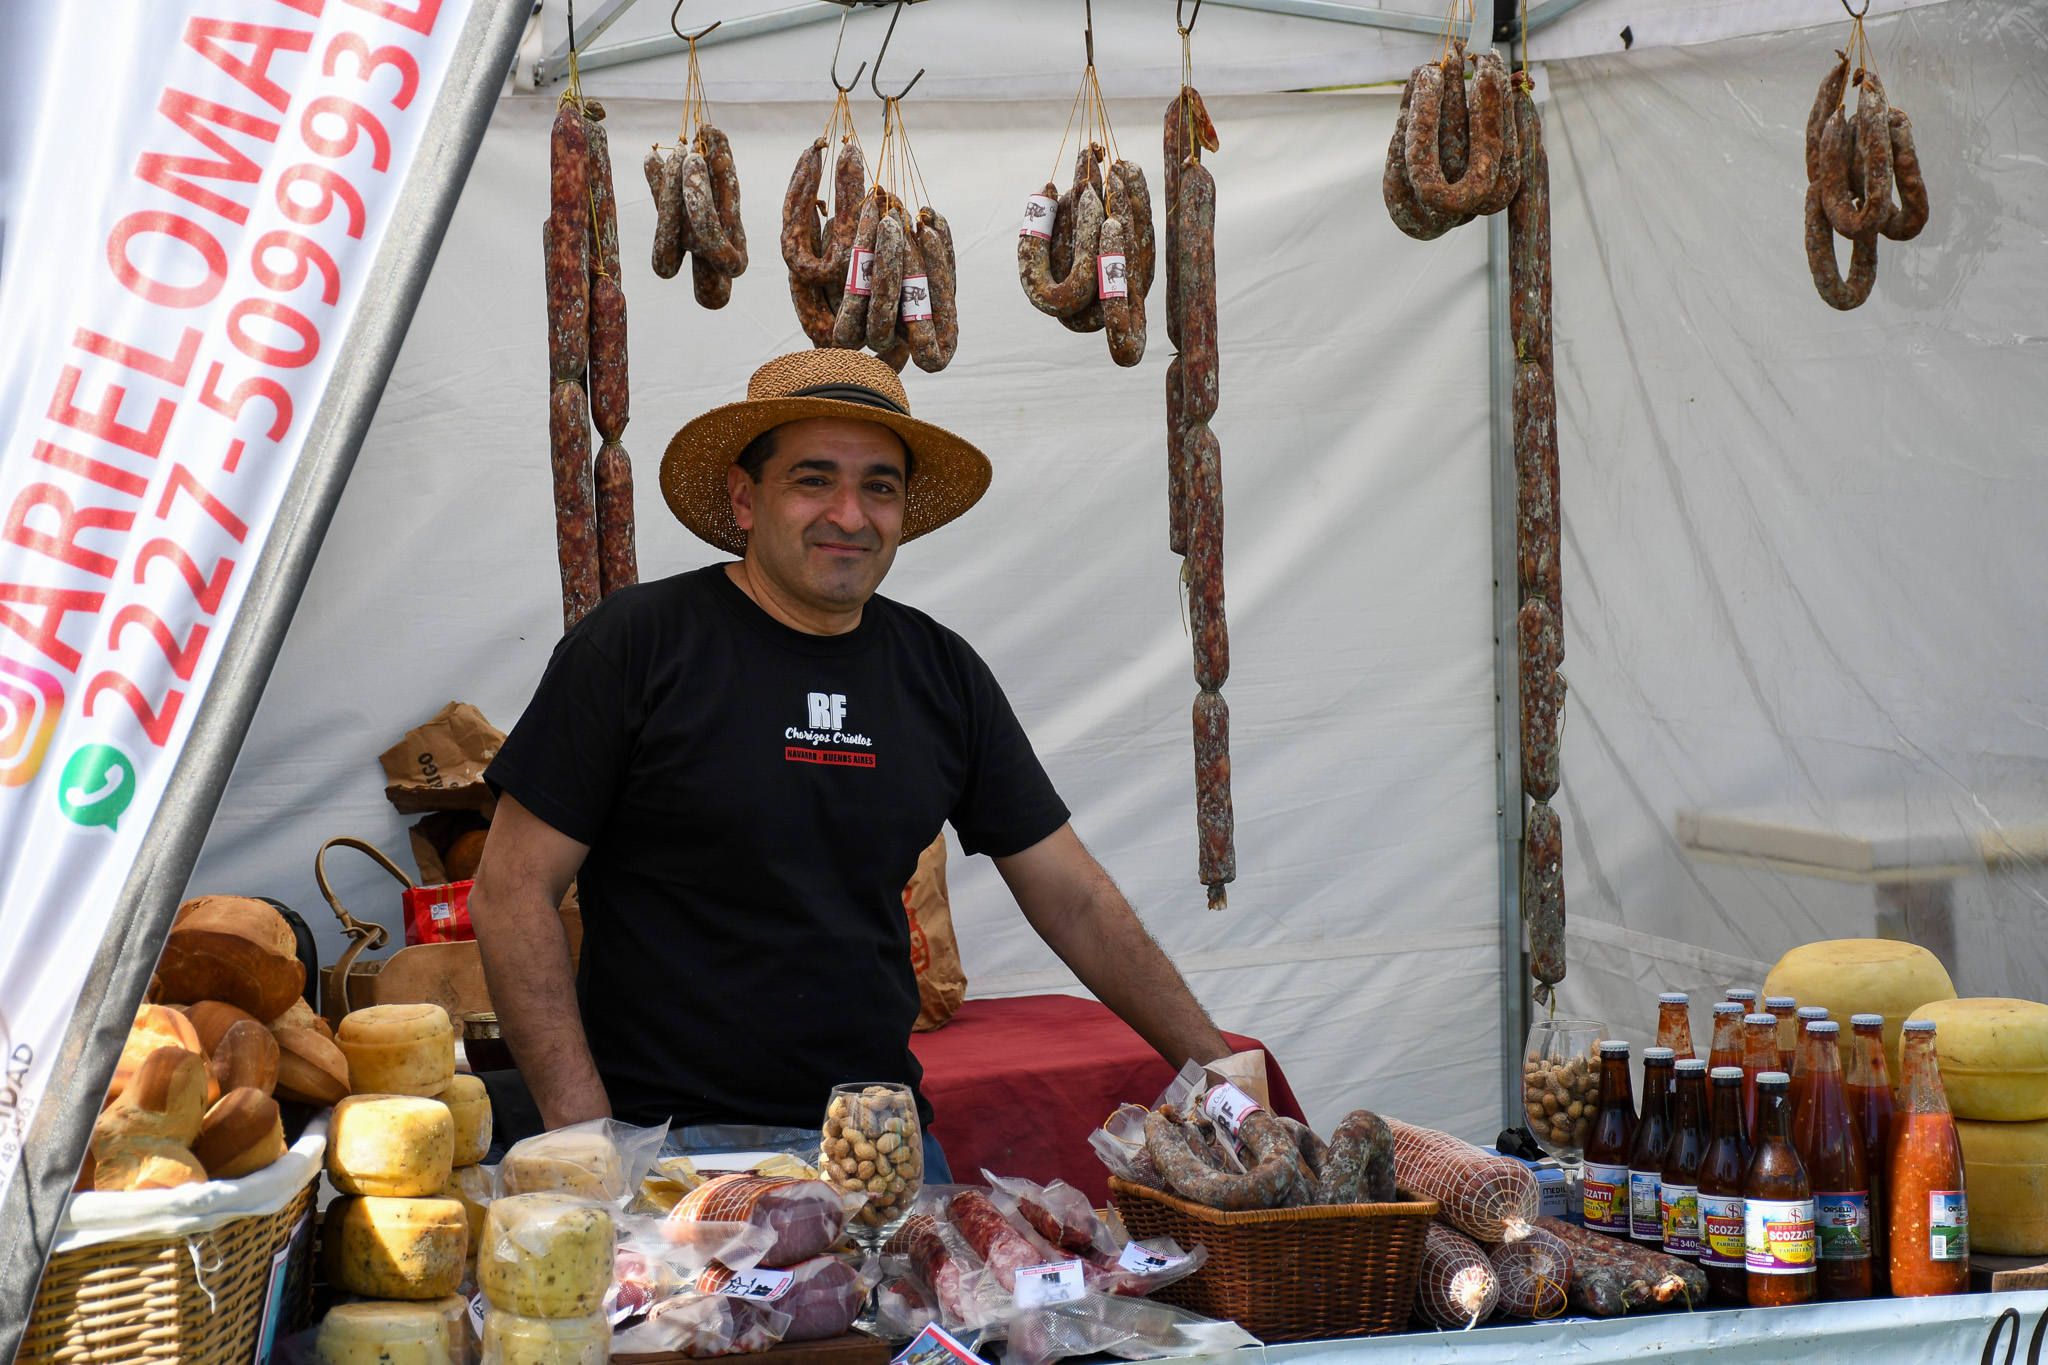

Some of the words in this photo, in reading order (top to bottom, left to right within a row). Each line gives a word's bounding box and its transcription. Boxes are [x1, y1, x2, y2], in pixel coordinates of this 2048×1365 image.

[0, 0, 327, 674] ARIELOMA
[807, 692, 847, 731] RF
[785, 727, 831, 746] Chorizos
[833, 732, 873, 747] Criollos
[787, 749, 817, 761] NAVARRO
[823, 753, 852, 763] BUENOS
[853, 755, 874, 765] AIRES
[1708, 1224, 1745, 1236] SCOZZA
